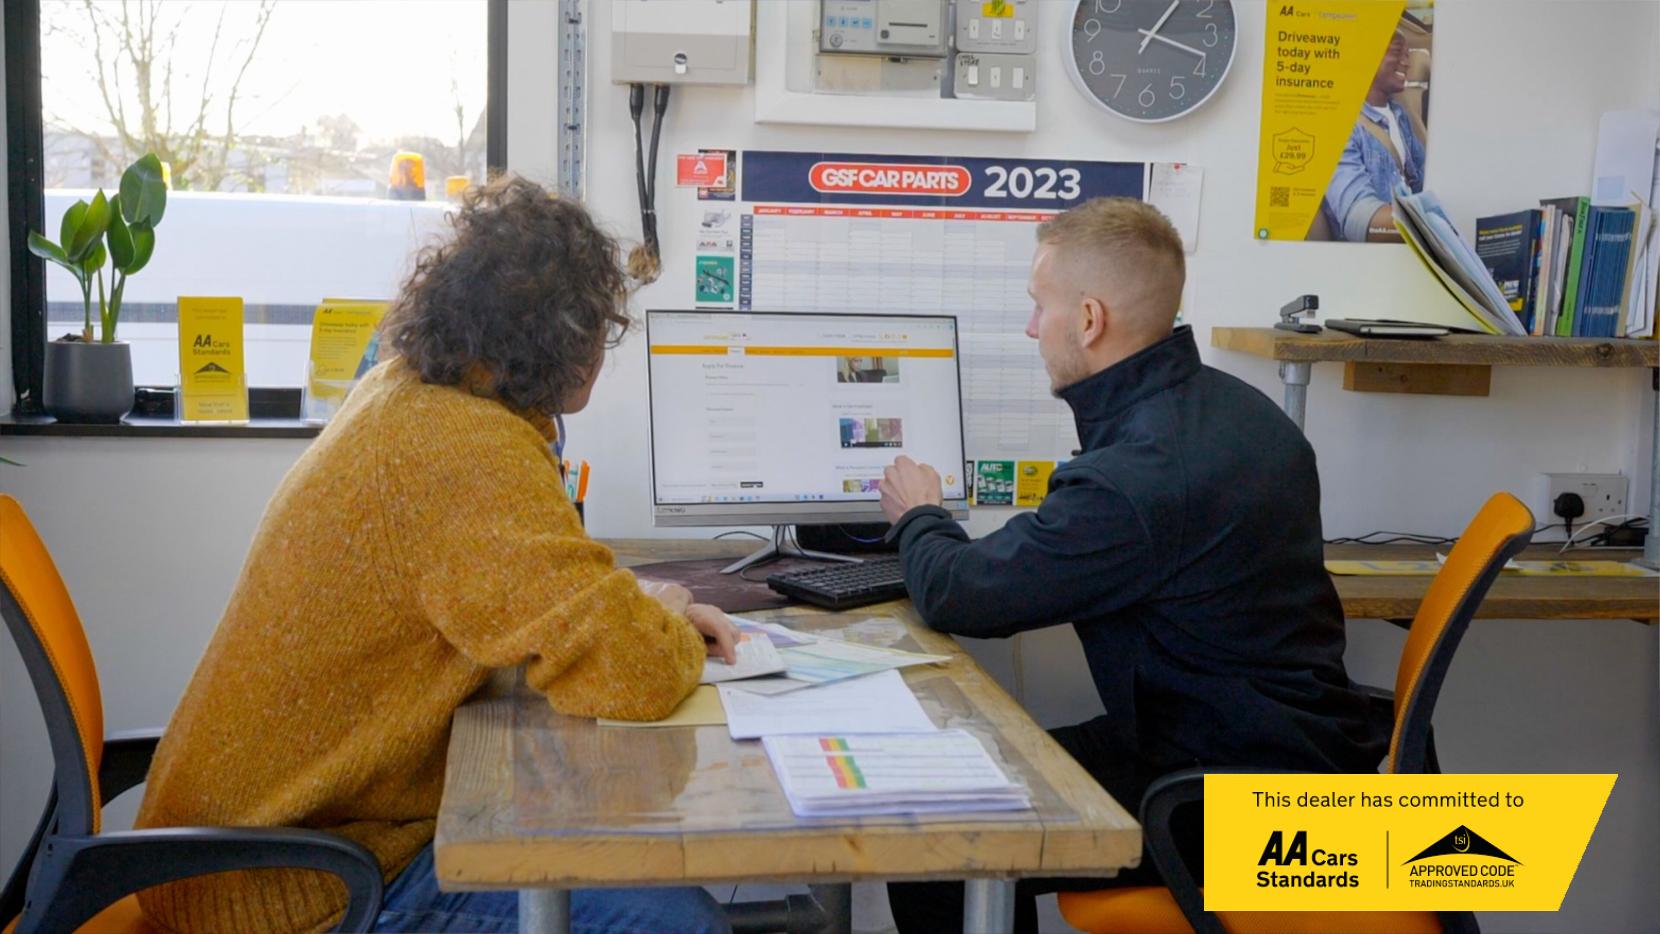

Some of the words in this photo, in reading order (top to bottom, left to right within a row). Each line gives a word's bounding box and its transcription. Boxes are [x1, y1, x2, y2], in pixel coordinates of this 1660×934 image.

[1280, 6, 1294, 16] AA
[1084, 18, 1101, 43] 9
[1202, 23, 1218, 48] 3
[1278, 31, 1340, 46] Driveaway
[1089, 50, 1105, 75] 8
[1278, 47, 1310, 60] today
[1314, 48, 1340, 59] with
[1192, 55, 1206, 78] 4
[1277, 61, 1311, 74] 5-day
[1110, 74, 1127, 99] 7
[1169, 76, 1185, 99] 5
[1276, 77, 1334, 88] insurance
[1138, 83, 1155, 107] 6
[821, 169, 858, 187] GSF
[859, 170, 898, 188] CAR
[901, 171, 960, 190] PARTS
[984, 166, 1081, 199] 2023
[193, 334, 211, 347] AA
